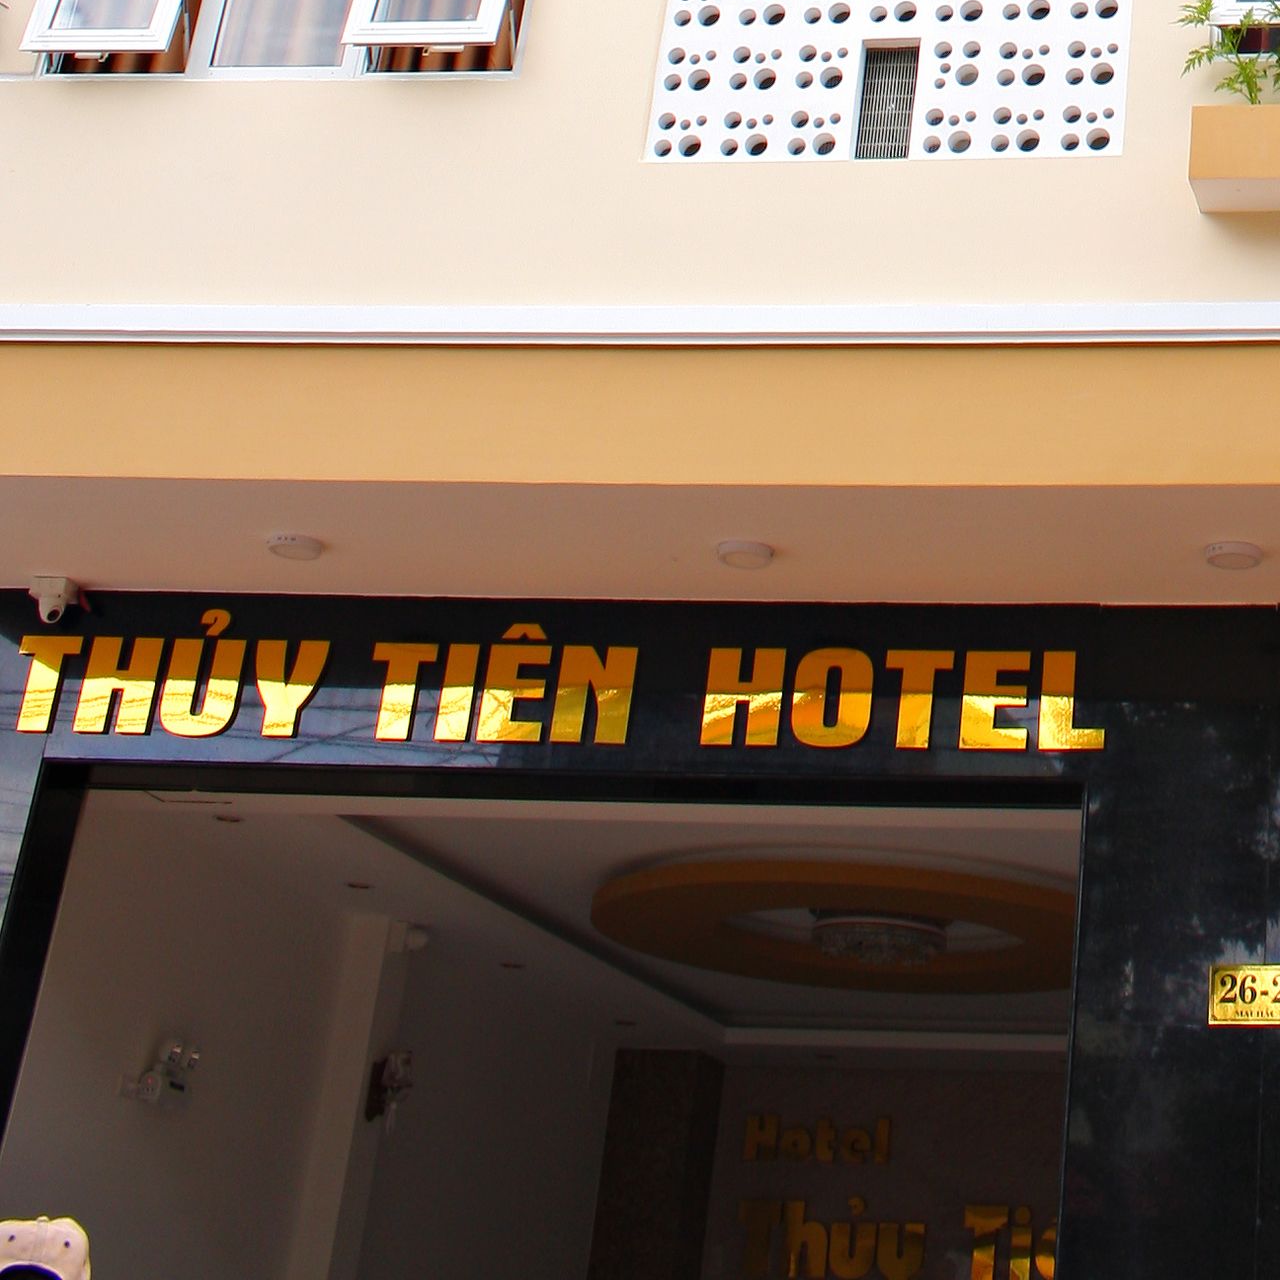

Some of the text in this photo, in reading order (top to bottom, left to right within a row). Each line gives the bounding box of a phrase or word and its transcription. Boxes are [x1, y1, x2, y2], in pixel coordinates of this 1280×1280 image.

[16, 608, 1106, 751] THỦY TIÊN HOTEL
[743, 1114, 892, 1164] Hotel
